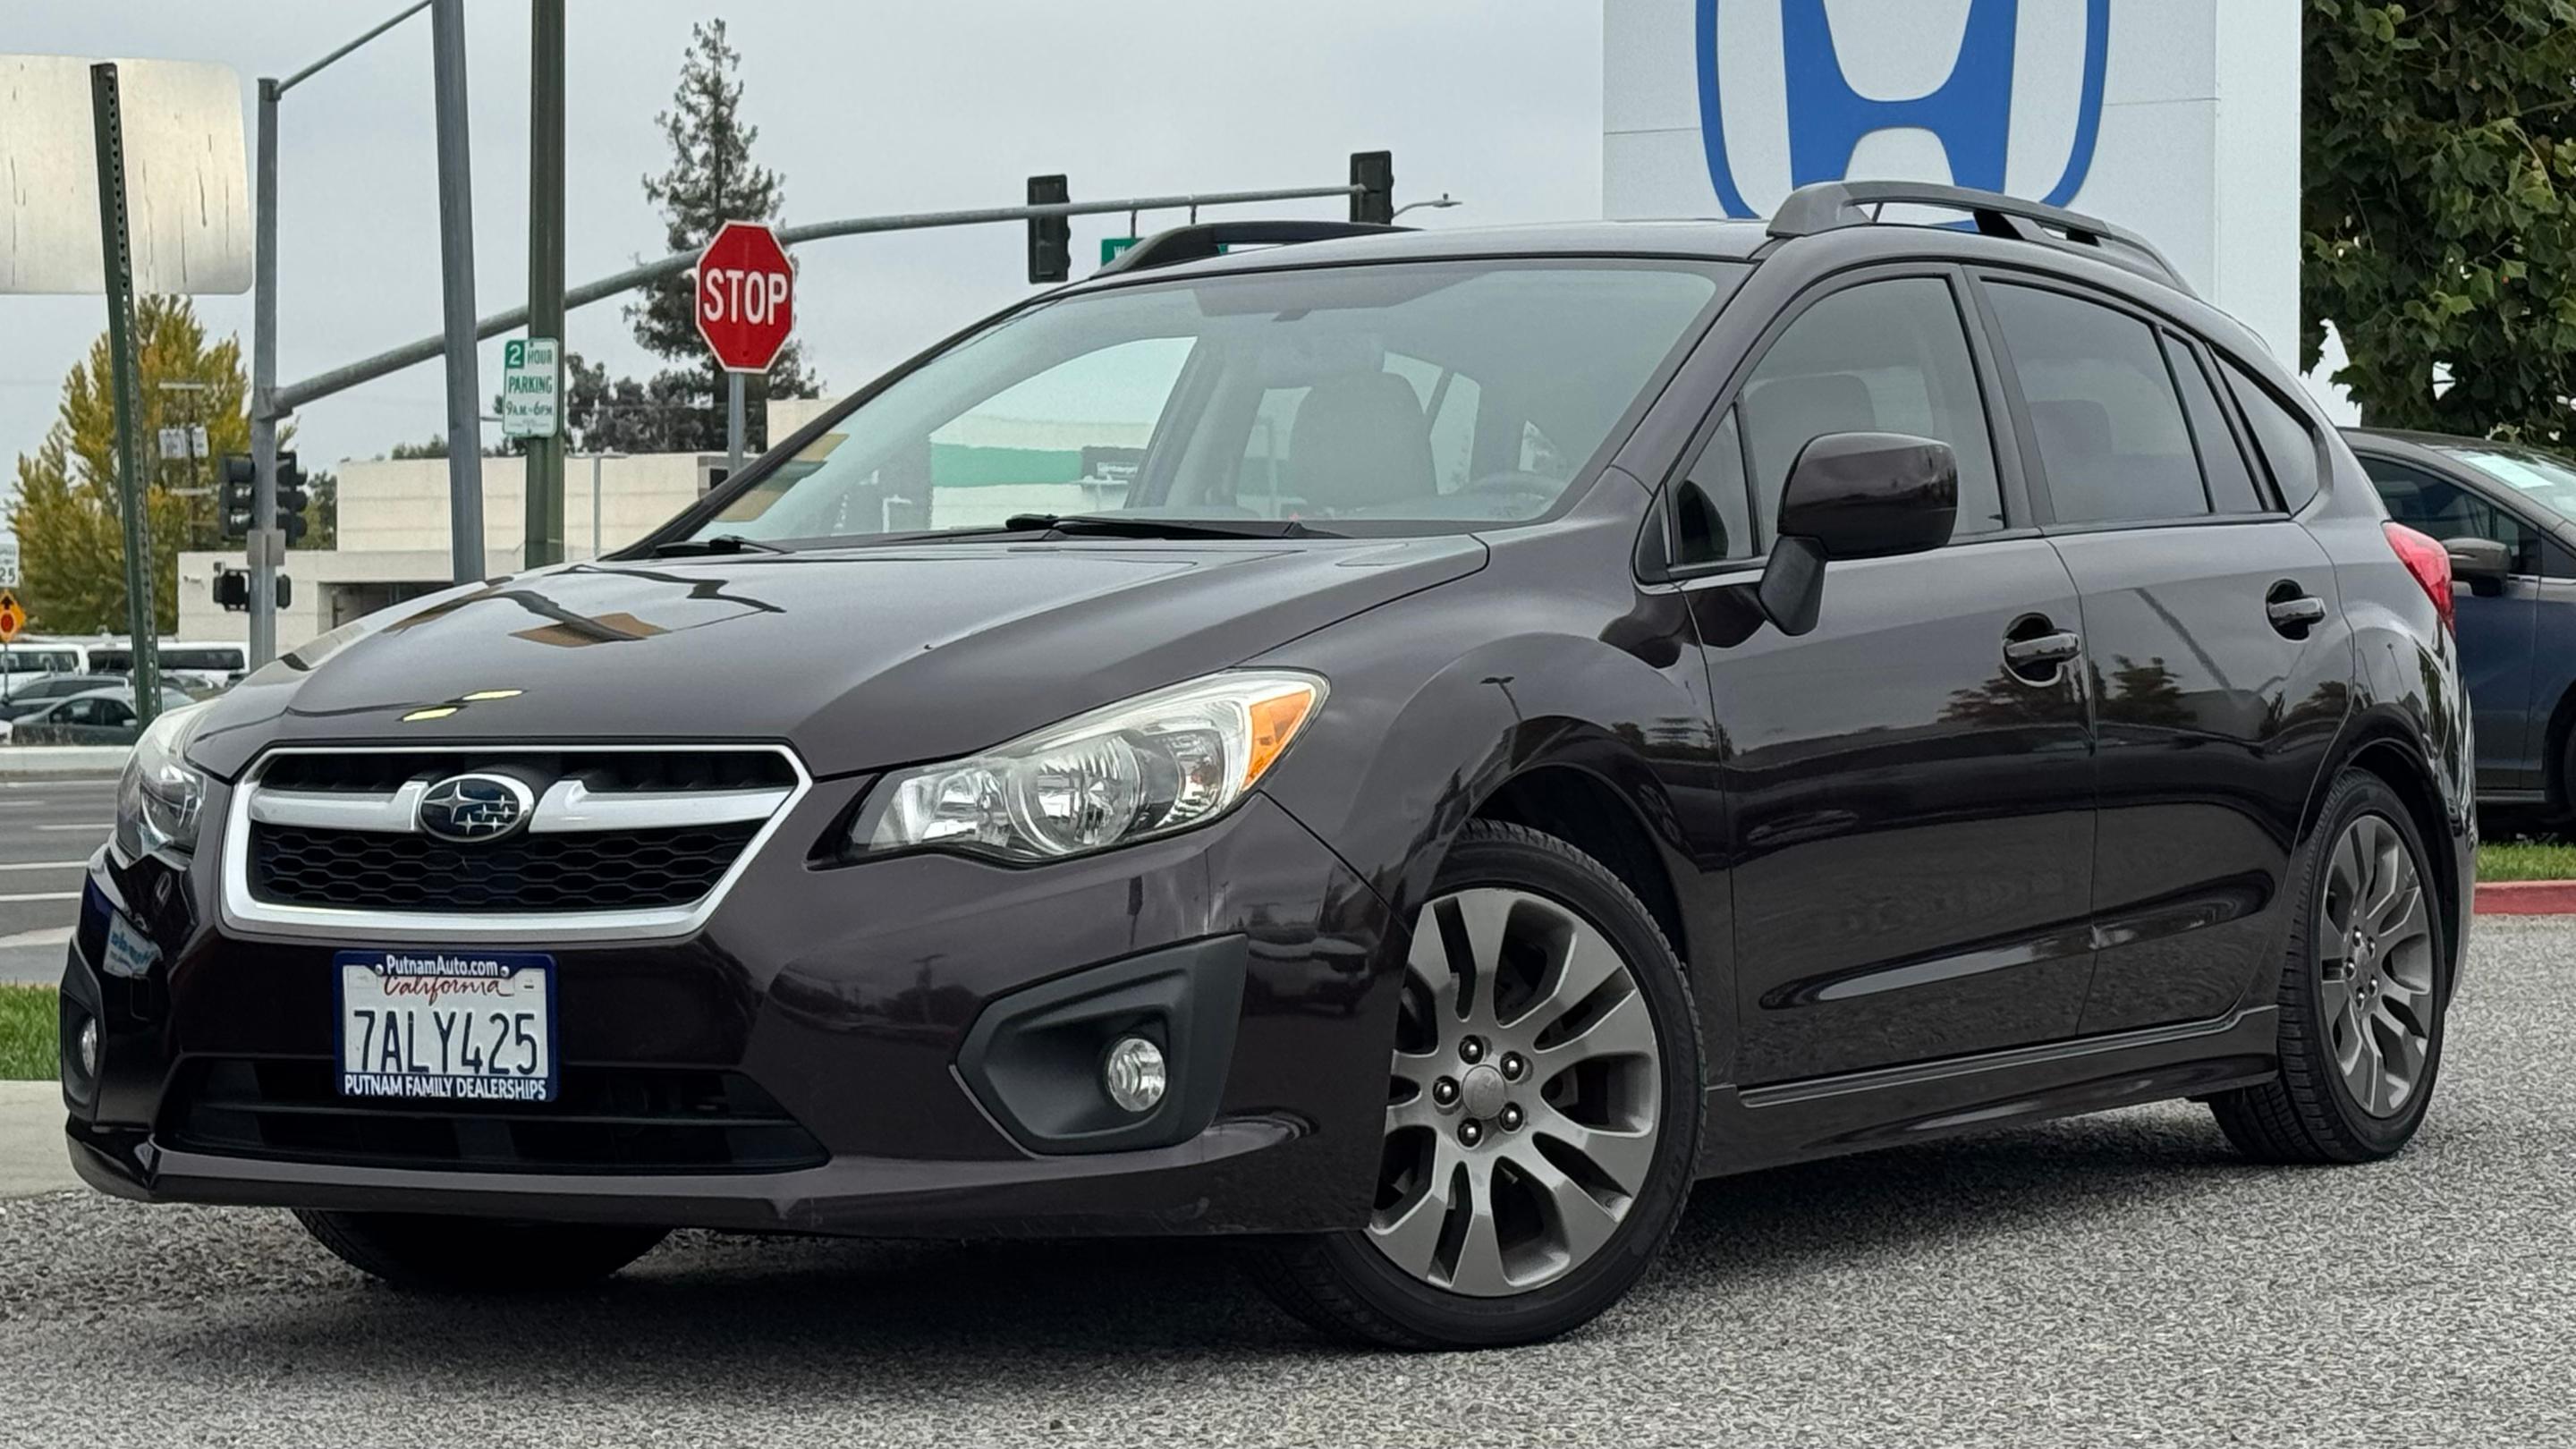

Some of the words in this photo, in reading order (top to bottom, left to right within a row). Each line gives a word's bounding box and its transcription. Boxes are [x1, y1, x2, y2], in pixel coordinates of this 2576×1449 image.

[703, 267, 788, 326] STOP
[508, 344, 521, 365] 2
[528, 349, 553, 365] HOUR
[508, 376, 553, 394] PARKING
[0, 566, 16, 584] 25
[386, 954, 499, 977] PutnamAuto.com
[384, 976, 515, 1007] California
[354, 1010, 538, 1075] 7ALY425
[344, 1075, 403, 1097] PUTNAM
[405, 1077, 453, 1098] FAMILY
[456, 1078, 547, 1101] DEALERSHIPS
